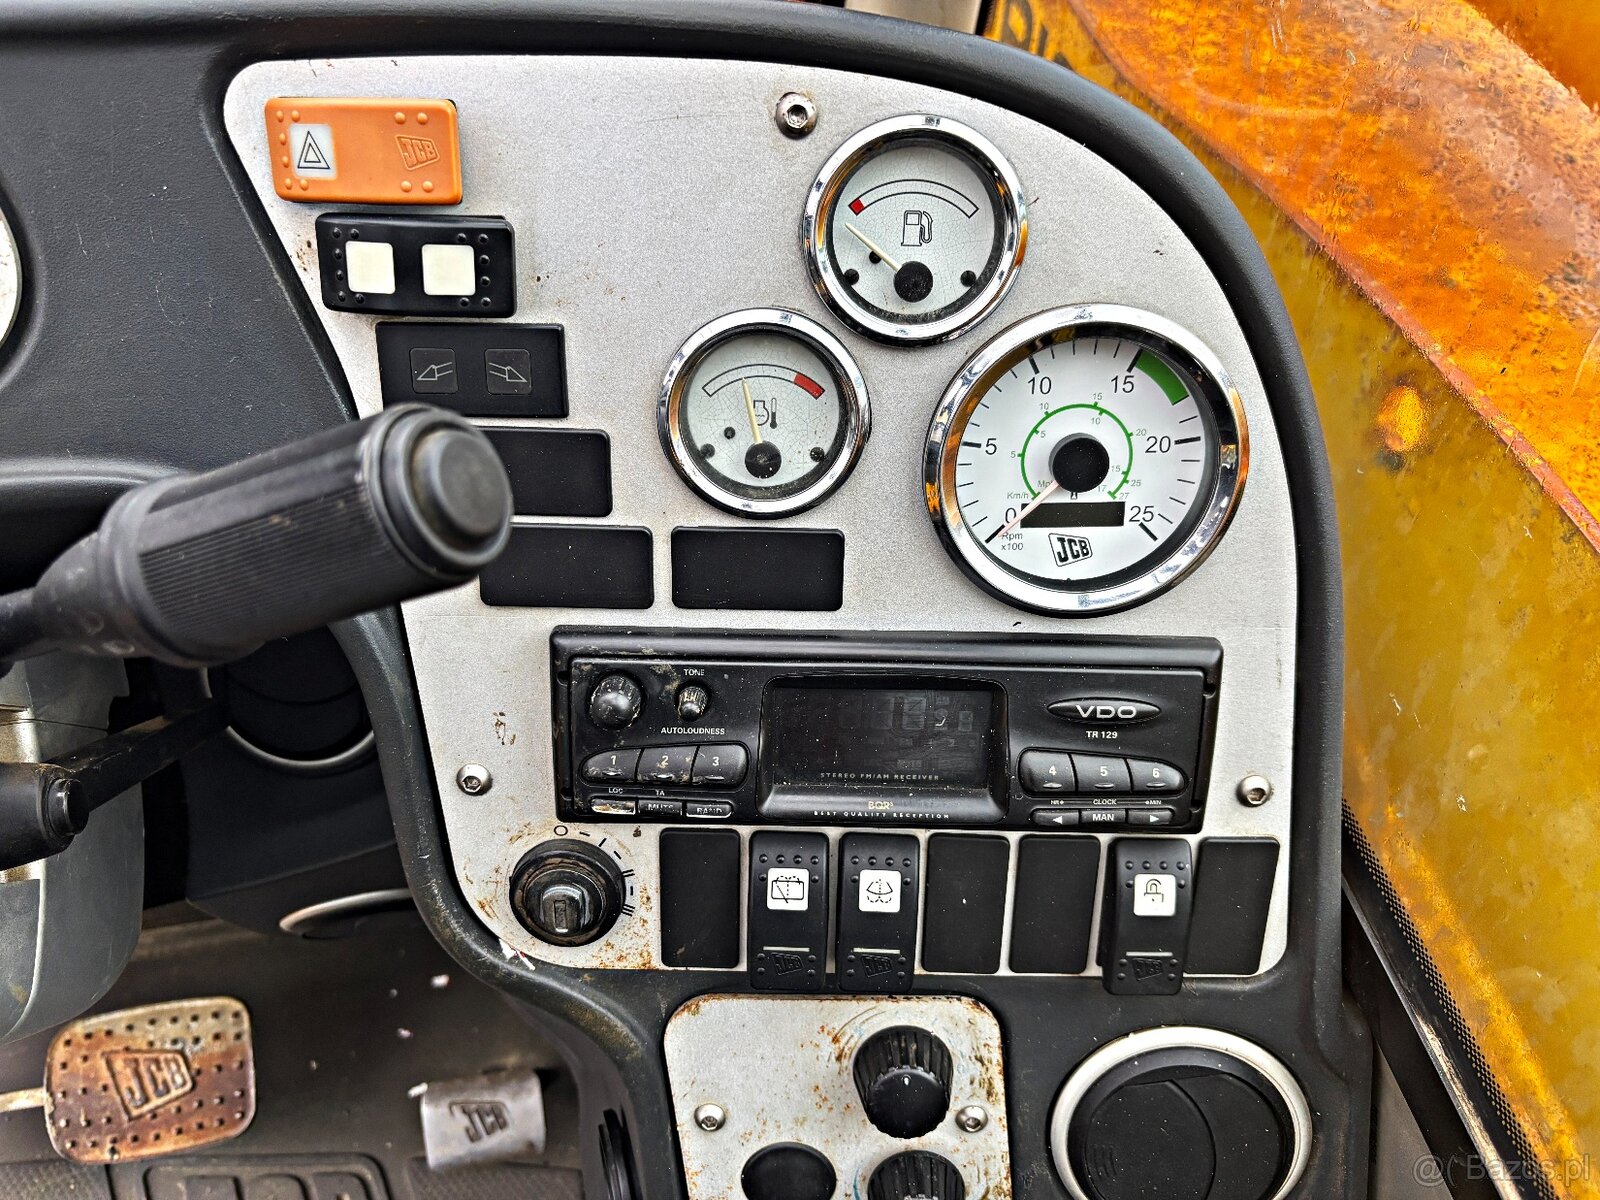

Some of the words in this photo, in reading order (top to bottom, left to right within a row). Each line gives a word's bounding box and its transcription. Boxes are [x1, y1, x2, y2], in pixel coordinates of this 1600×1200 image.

[401, 138, 436, 166] JCB
[1027, 376, 1052, 395] 10
[1110, 375, 1135, 394] 15
[1092, 393, 1103, 401] 15
[1039, 402, 1050, 411] 10
[1090, 417, 1101, 425] 10
[1040, 430, 1047, 438] 5
[1135, 428, 1147, 437] 20
[984, 437, 998, 456] 5
[1144, 435, 1172, 454] 20
[1010, 450, 1017, 459] 5
[1111, 465, 1121, 473] 15
[1130, 479, 1142, 487] 25
[1006, 492, 1029, 500] Km/h
[1119, 492, 1130, 500] 27
[1004, 507, 1018, 526] 0
[1128, 505, 1155, 523] 25
[1000, 532, 1023, 543] Rpm
[1000, 542, 1024, 551] x100
[1056, 537, 1090, 563] JCB
[683, 668, 705, 676] TONE
[1075, 704, 1137, 719] VDO
[660, 727, 726, 735] AUTOLOUDNESS
[1085, 730, 1099, 739] TR
[1100, 731, 1118, 739] 129
[610, 755, 617, 765] 1
[660, 755, 669, 768] 2
[712, 756, 720, 767] 3
[1048, 765, 1057, 776] 4
[1099, 766, 1109, 777] 5
[1151, 768, 1161, 778] 6
[608, 787, 624, 795] LOC
[655, 789, 665, 797] TA
[1092, 798, 1118, 806] CLOCK
[1092, 813, 1115, 822] MAN
[124, 1057, 187, 1108] JCB
